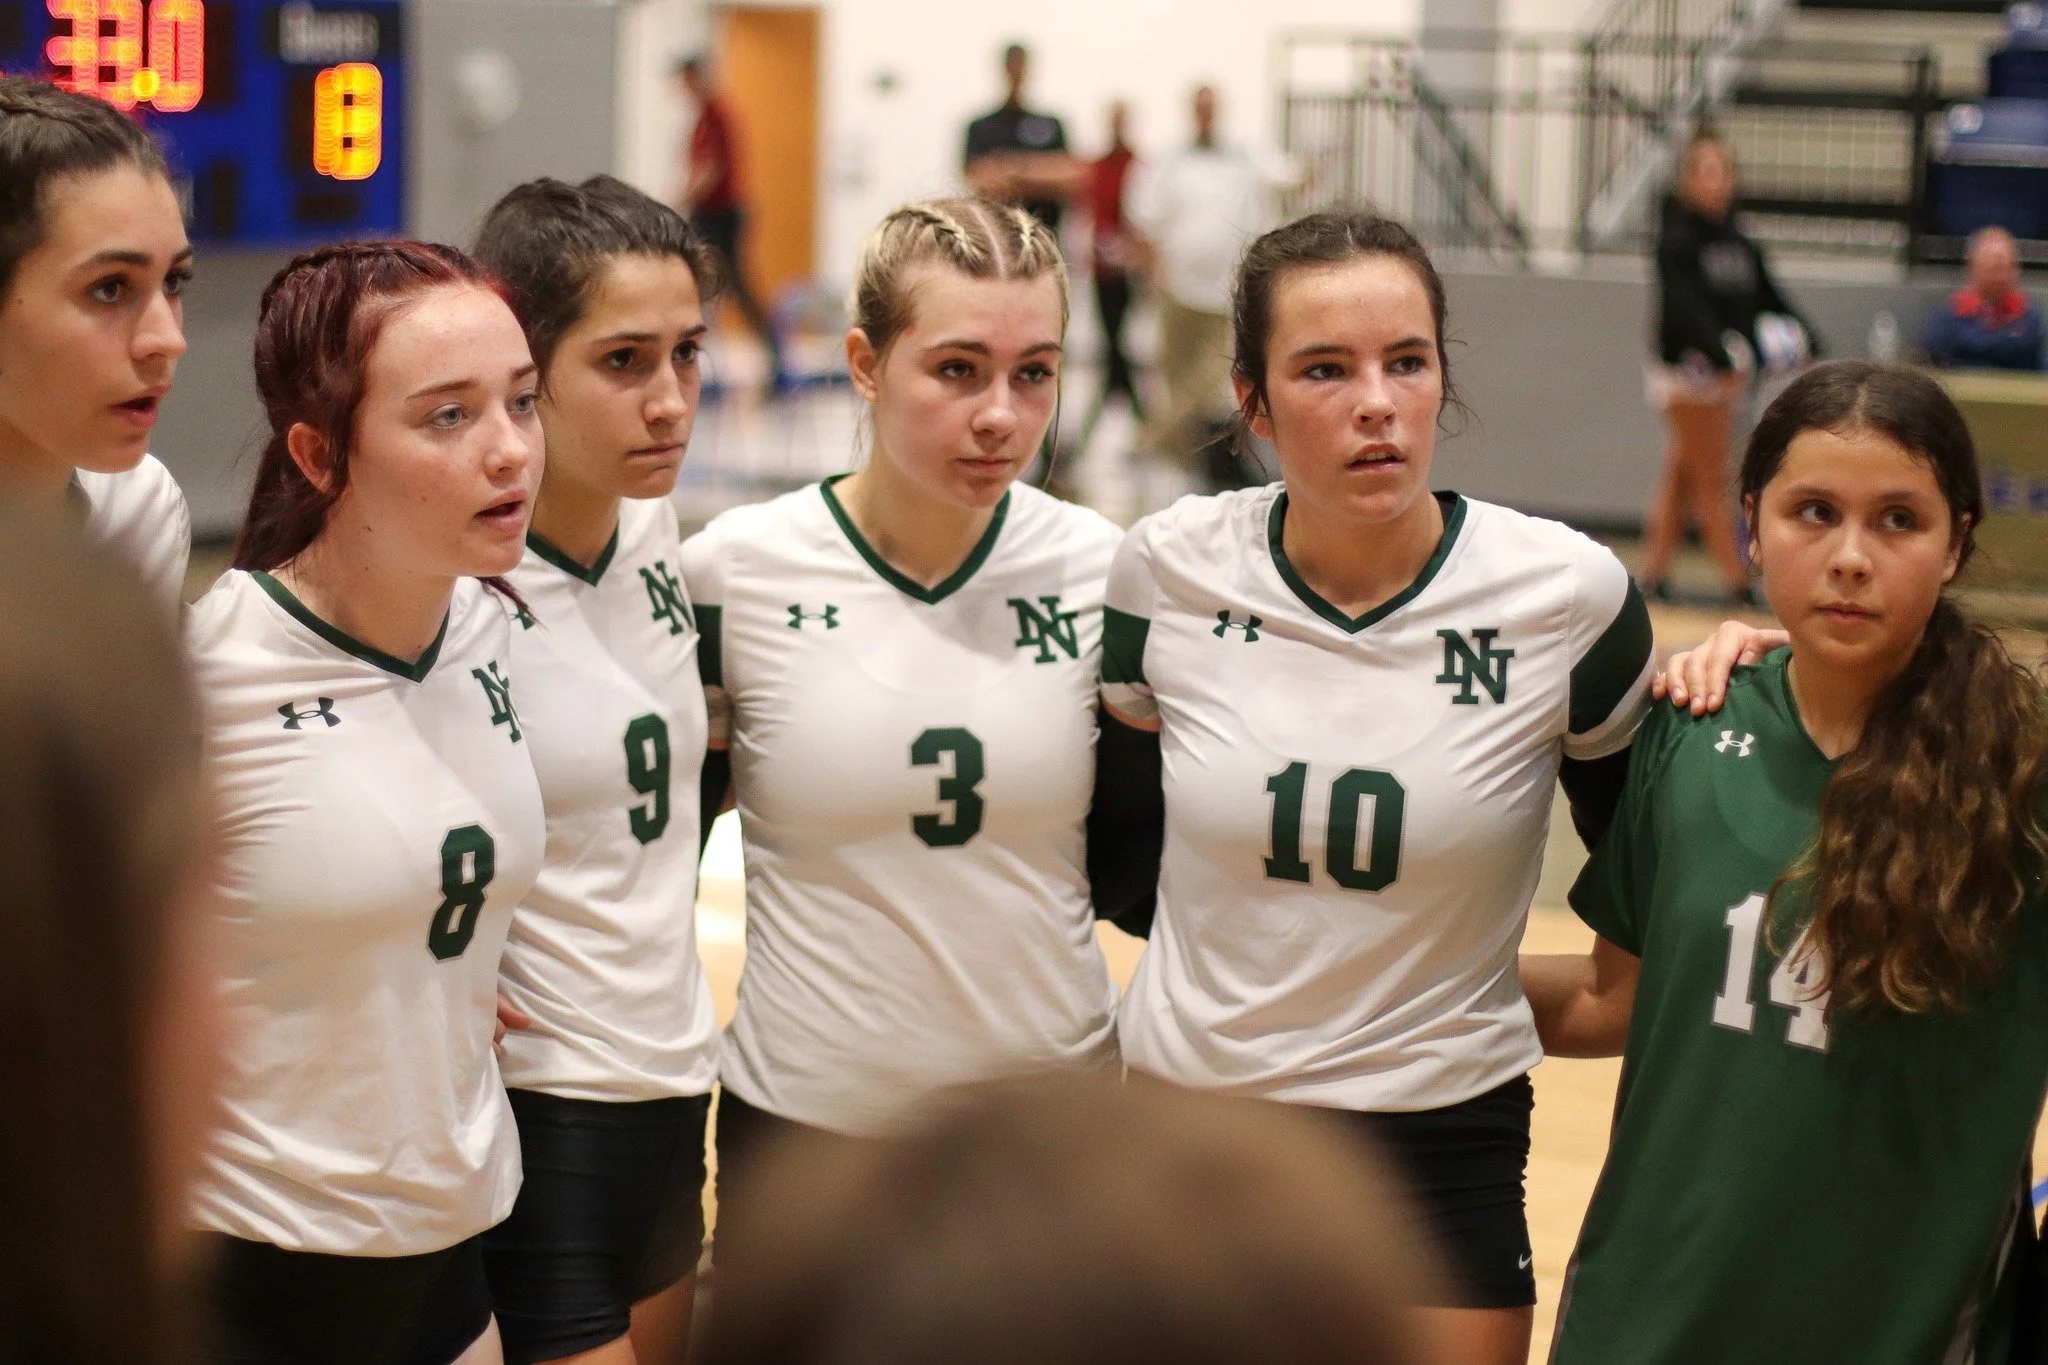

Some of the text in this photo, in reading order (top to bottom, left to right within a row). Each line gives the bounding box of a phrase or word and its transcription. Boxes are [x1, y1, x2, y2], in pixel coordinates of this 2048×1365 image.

[623, 712, 671, 845] 9
[909, 726, 985, 848] 3
[1262, 760, 1408, 892] 10
[427, 824, 495, 962] 8
[1710, 891, 1832, 1053] 14
